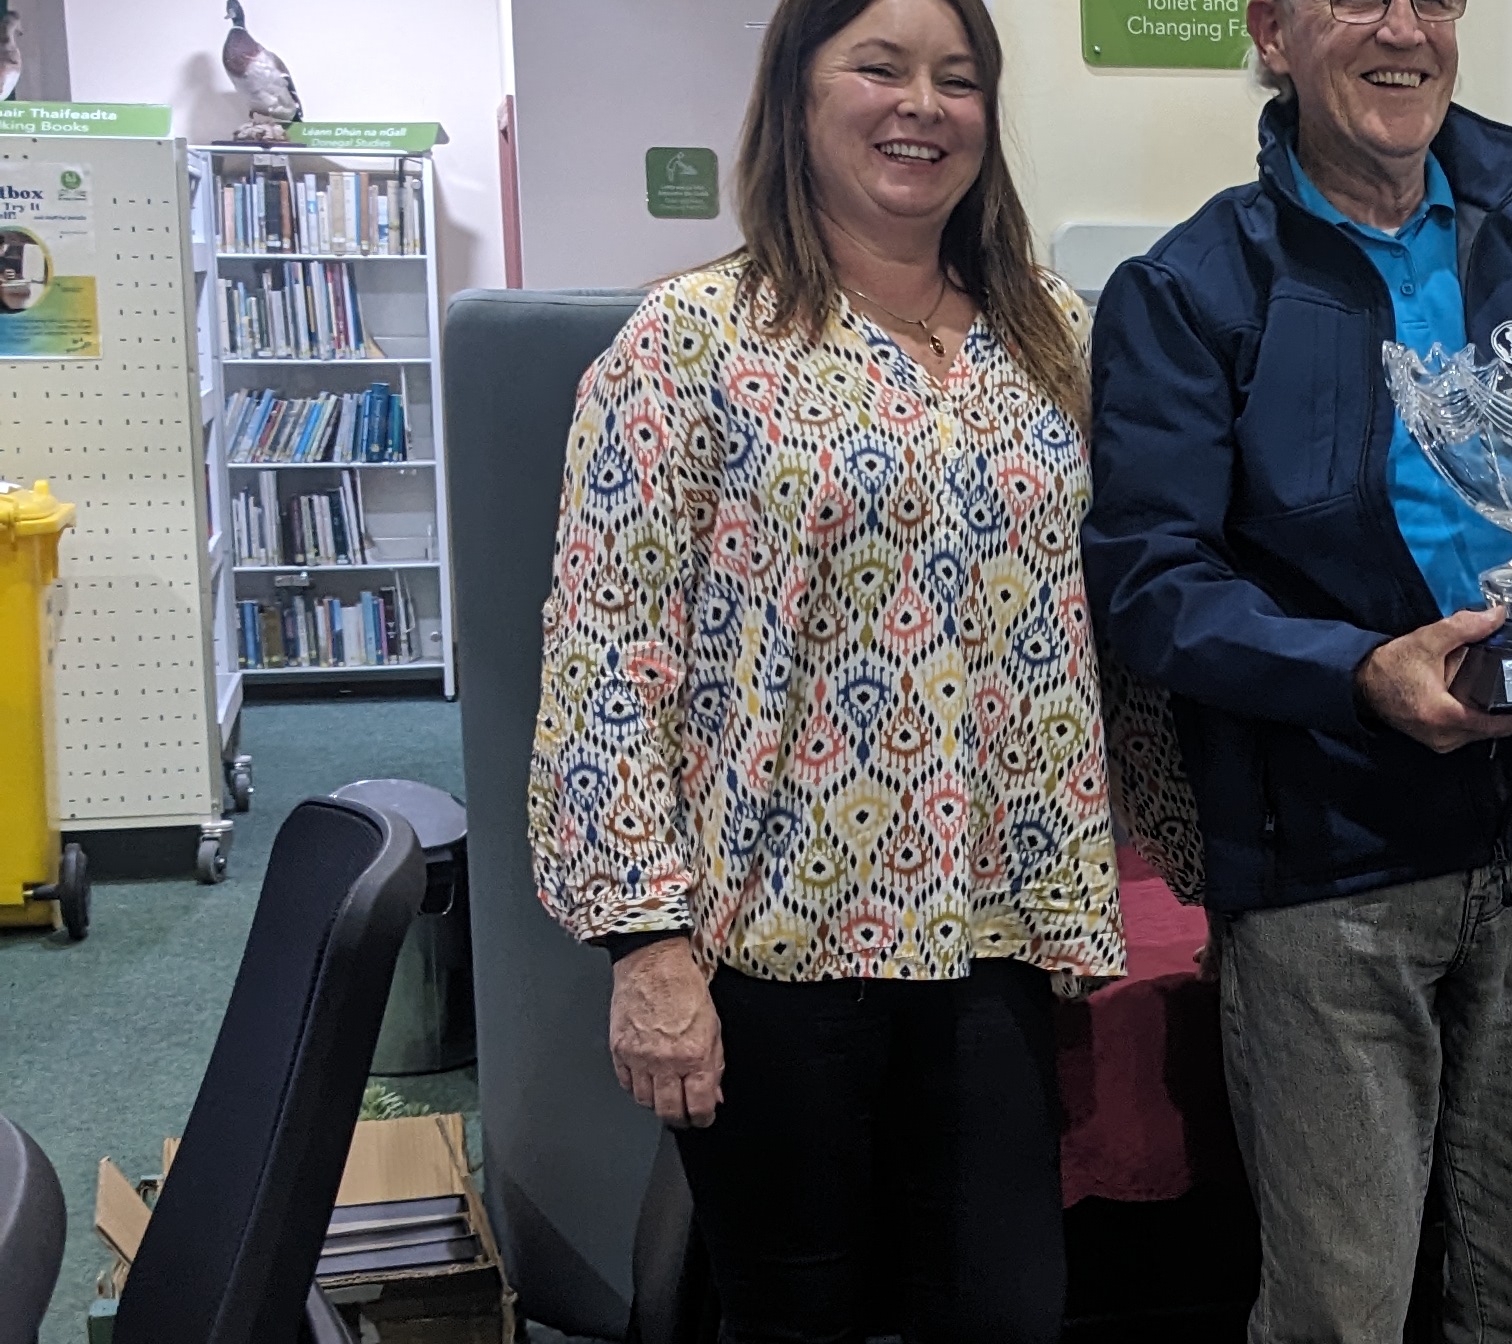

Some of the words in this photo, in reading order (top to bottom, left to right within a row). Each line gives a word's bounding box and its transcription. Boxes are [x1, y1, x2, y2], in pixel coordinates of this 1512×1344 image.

[1127, 16, 1223, 42] Changing
[1229, 20, 1251, 38] Fa
[0, 108, 25, 118] air
[30, 108, 118, 121] Thaifeadta
[41, 121, 90, 133] Books
[379, 127, 408, 137] nGall
[311, 138, 352, 149] Donegal
[355, 138, 392, 148] Studies
[5, 202, 25, 213] Try
[30, 202, 40, 211] It
